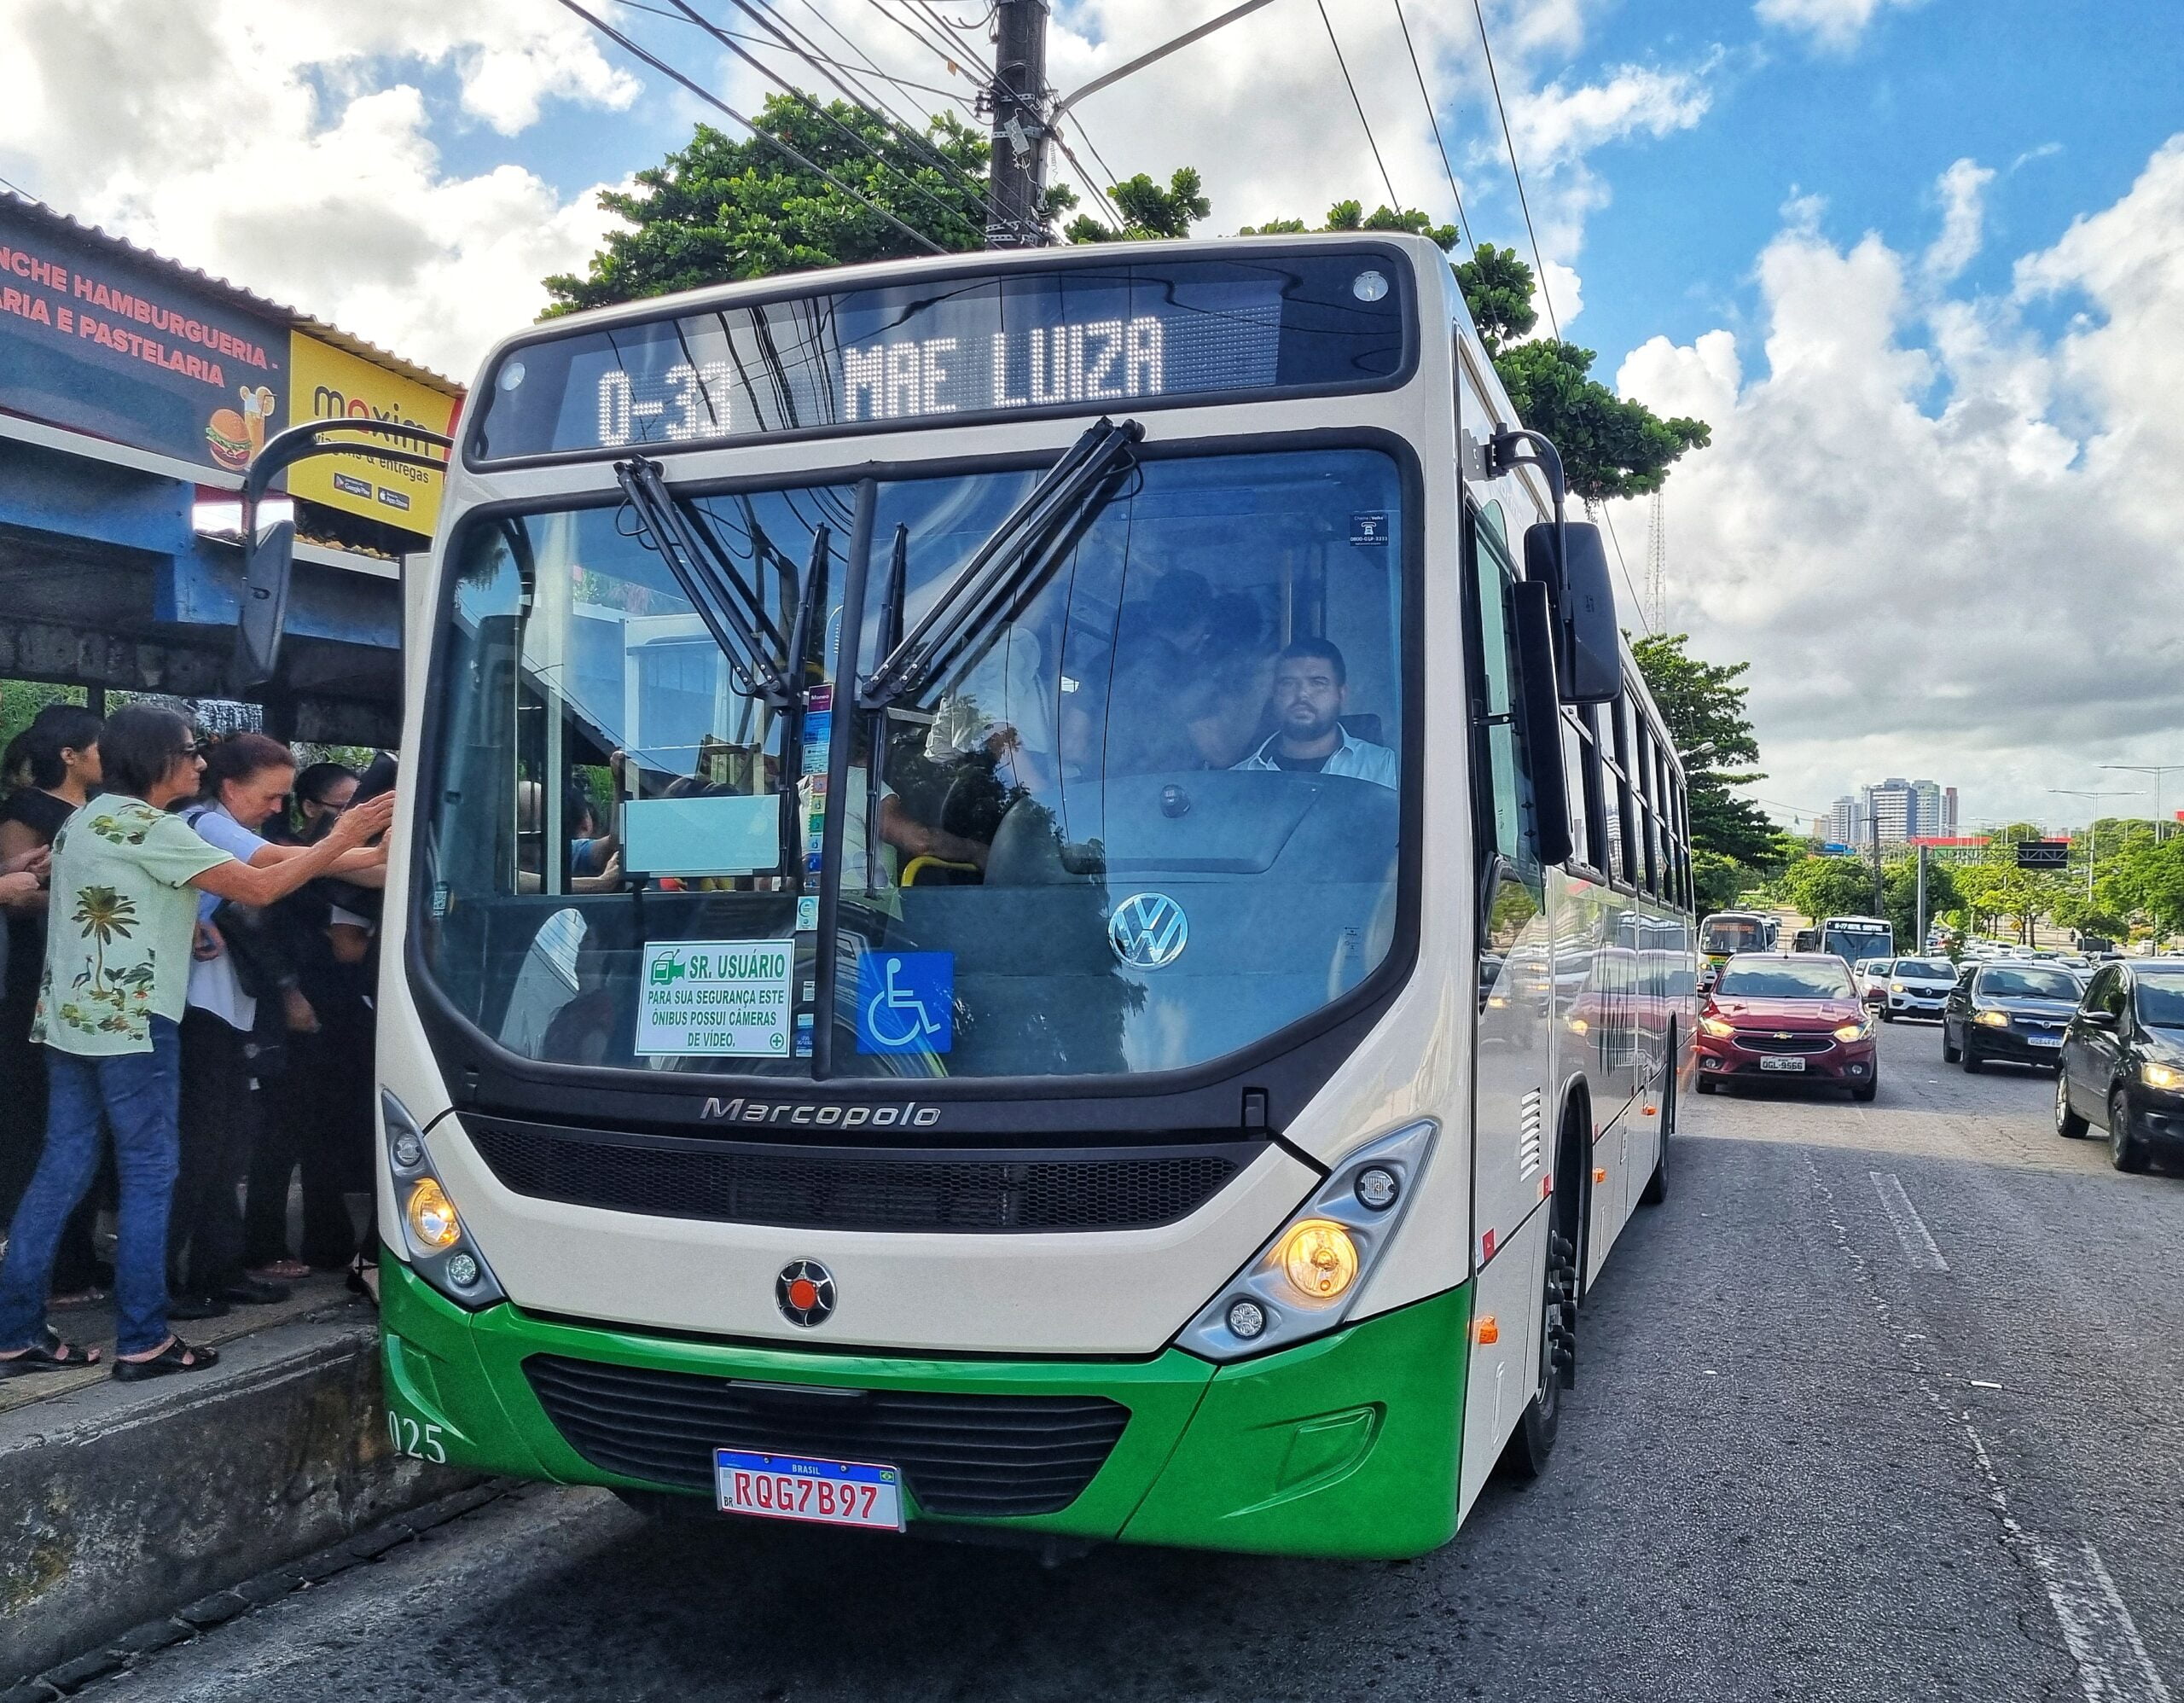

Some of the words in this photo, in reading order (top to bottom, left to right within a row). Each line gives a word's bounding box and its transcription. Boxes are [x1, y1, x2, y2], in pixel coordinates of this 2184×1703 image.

[74, 274, 268, 370] HAMBURGUERIA
[57, 306, 73, 334] E
[80, 315, 225, 388] PASTELARIA
[845, 338, 956, 421] MAE
[992, 316, 1163, 407] LUIZA
[689, 955, 712, 979] SR.
[718, 949, 786, 979] USUÁRIO
[648, 991, 672, 1005] PARA
[675, 991, 694, 1005] SUA
[696, 990, 756, 1008] SEGURANÇA
[758, 990, 785, 1004] ESTE
[690, 1012, 726, 1026] POSSUI
[729, 1008, 777, 1026] CÂMERAS
[688, 1032, 701, 1047] DE
[704, 1029, 735, 1047] VÍDEO.
[700, 1097, 941, 1130] Marcopolo
[792, 1464, 821, 1475] BRASIL
[724, 1496, 734, 1508] BR
[735, 1472, 878, 1520] RQG7B97
